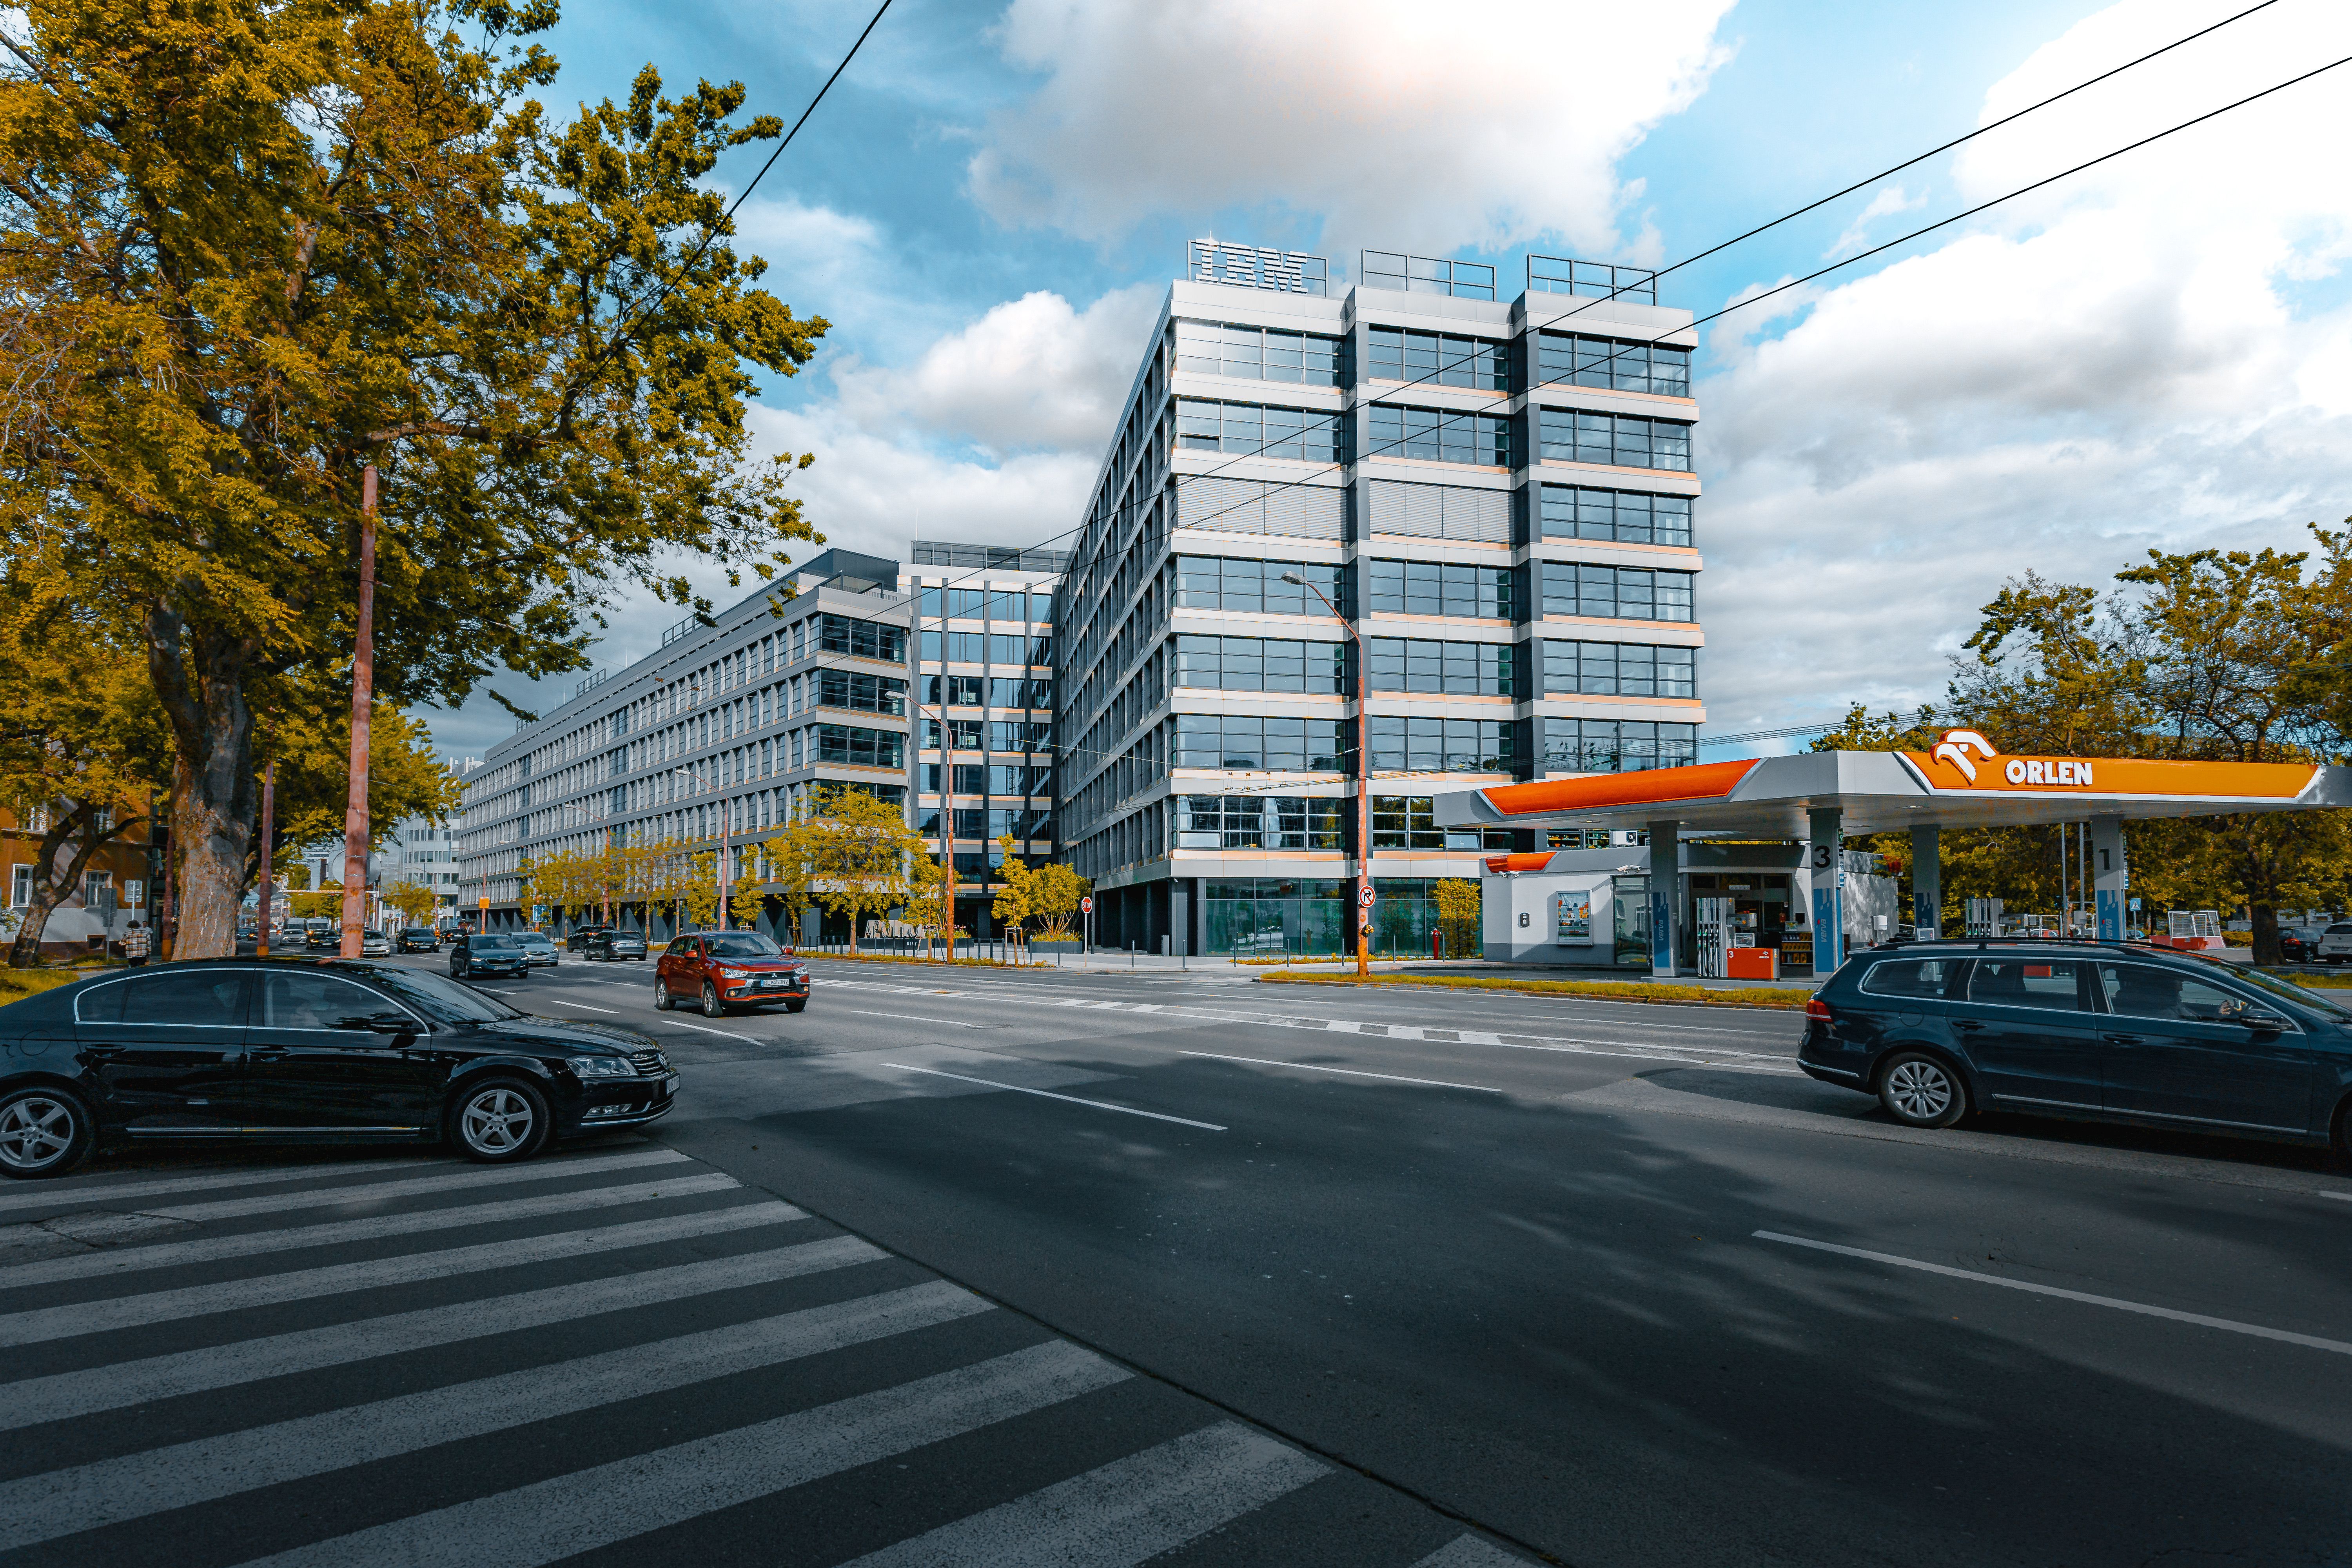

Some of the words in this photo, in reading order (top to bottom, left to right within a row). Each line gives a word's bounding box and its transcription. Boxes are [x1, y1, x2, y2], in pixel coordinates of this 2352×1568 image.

[1196, 238, 1308, 294] IBM
[2005, 760, 2092, 785] ORLEN
[1814, 845, 1831, 868] 3
[2098, 848, 2110, 870] 1
